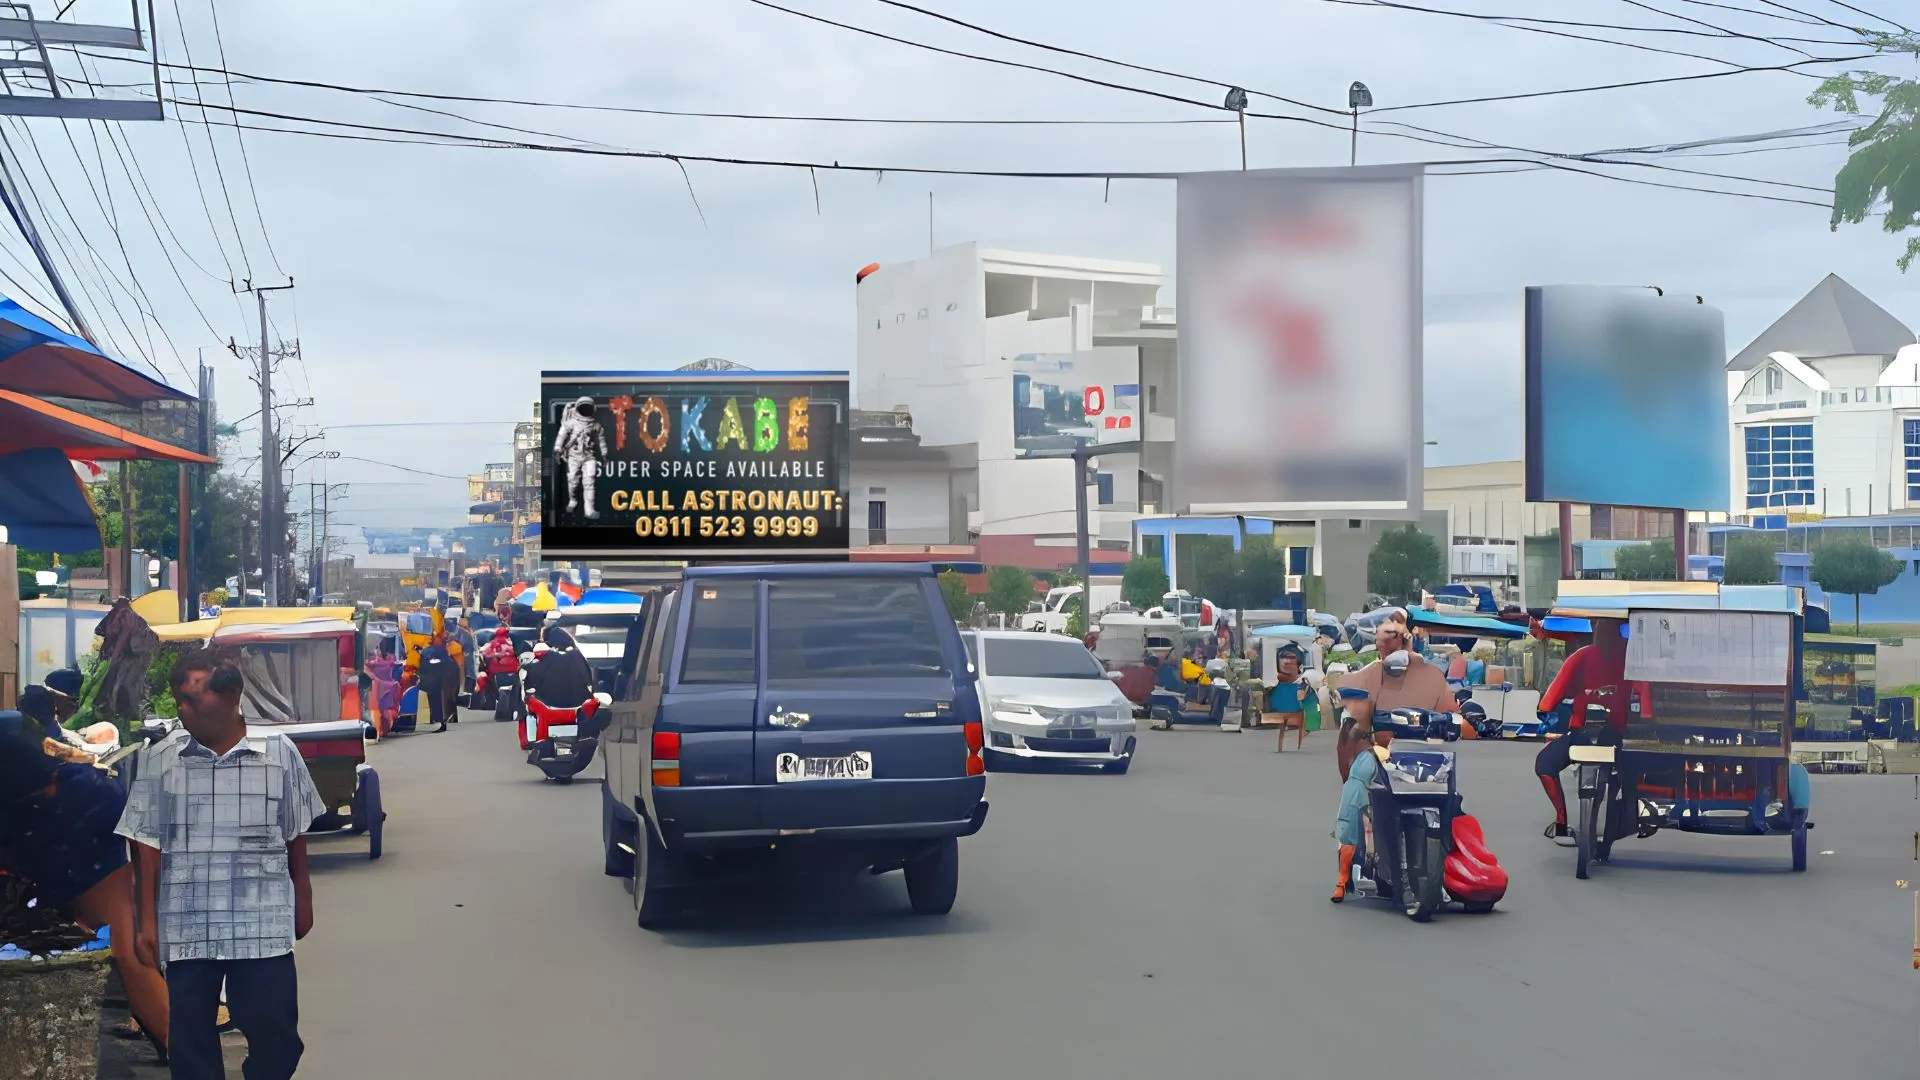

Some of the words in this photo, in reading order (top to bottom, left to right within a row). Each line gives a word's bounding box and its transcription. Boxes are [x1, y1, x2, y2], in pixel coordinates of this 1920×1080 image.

[608, 395, 810, 453] TOKABE
[596, 461, 651, 477] SUPER
[661, 461, 717, 477] SPACE
[726, 461, 825, 477] AVAILABLE
[611, 490, 675, 511] CALL
[682, 490, 843, 511] ASTRONAUT:
[635, 516, 691, 537] 0811
[699, 516, 746, 537] 523
[753, 516, 819, 537] 9999
